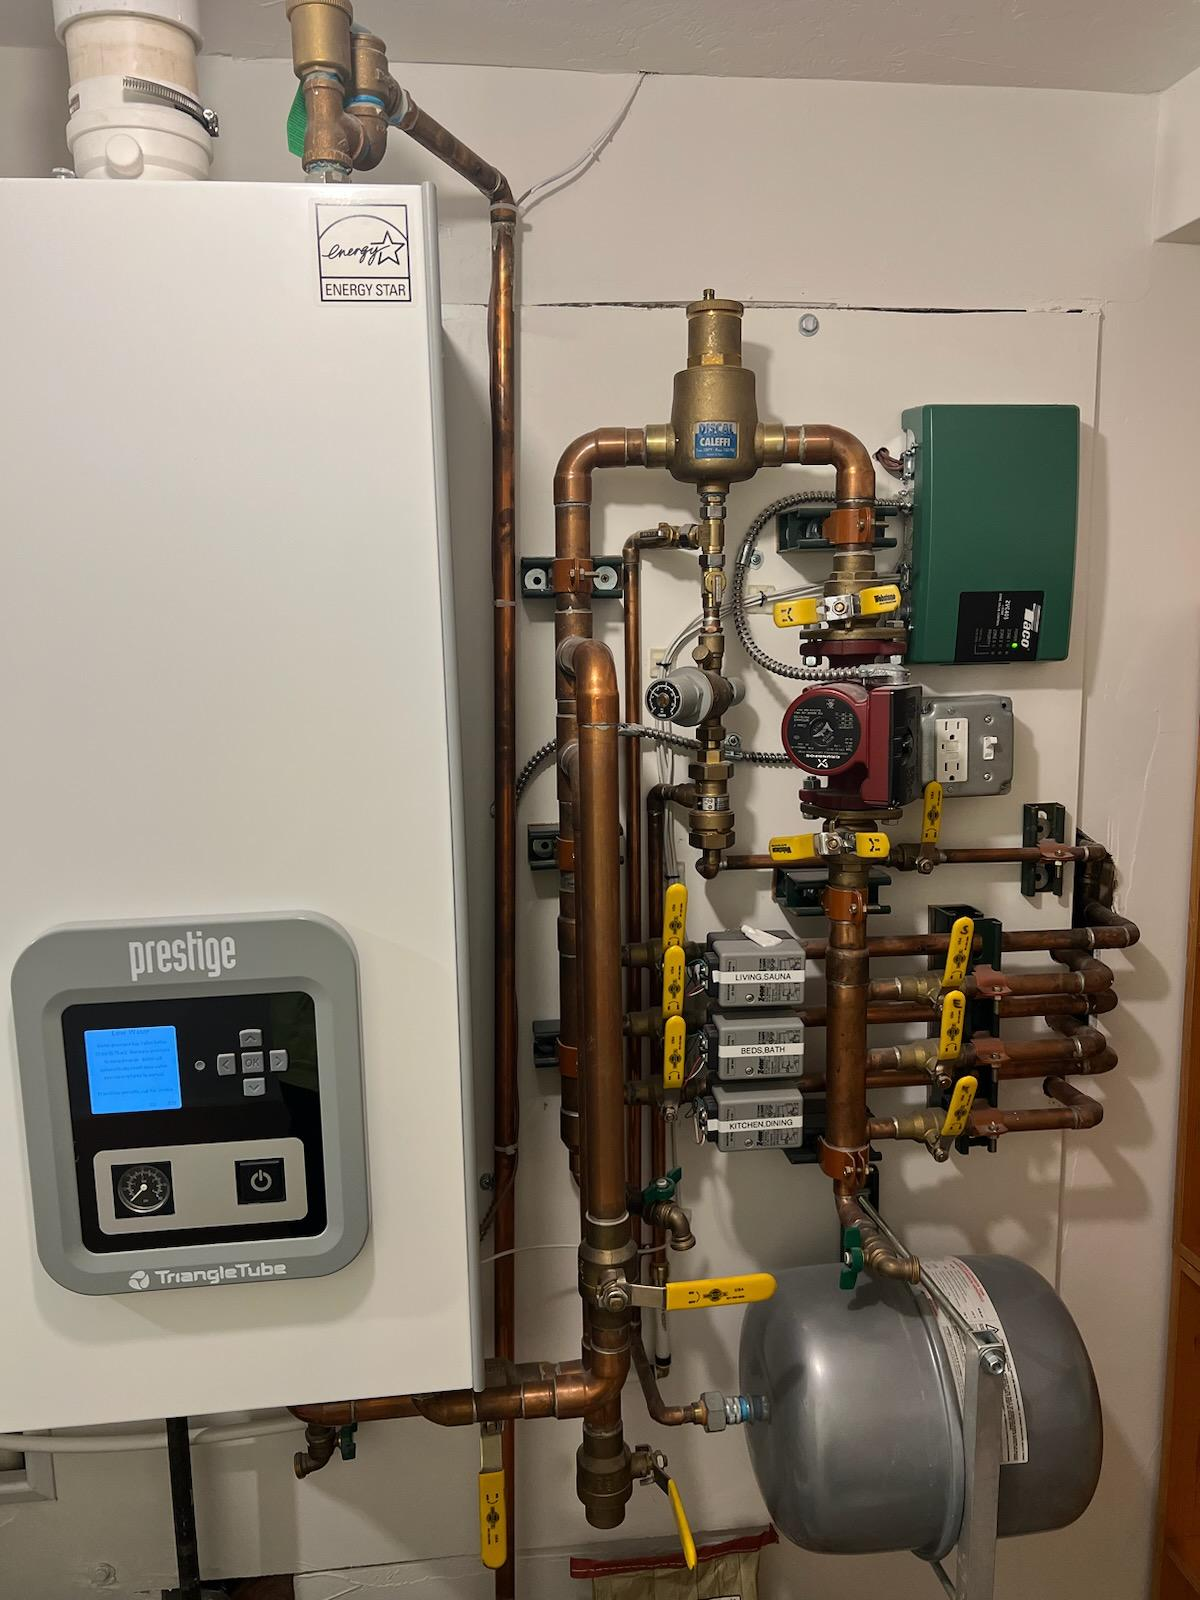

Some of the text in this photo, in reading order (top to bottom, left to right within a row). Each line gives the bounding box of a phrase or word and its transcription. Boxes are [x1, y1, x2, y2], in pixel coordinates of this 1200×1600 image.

[322, 244, 384, 266] energy
[325, 284, 406, 296] ENERGY STAR
[700, 437, 730, 447] CALEFFI
[1021, 603, 1041, 648] Taco
[128, 931, 236, 982] prestige
[245, 1057, 261, 1068] OK
[154, 1262, 287, 1284] TriangleTube
